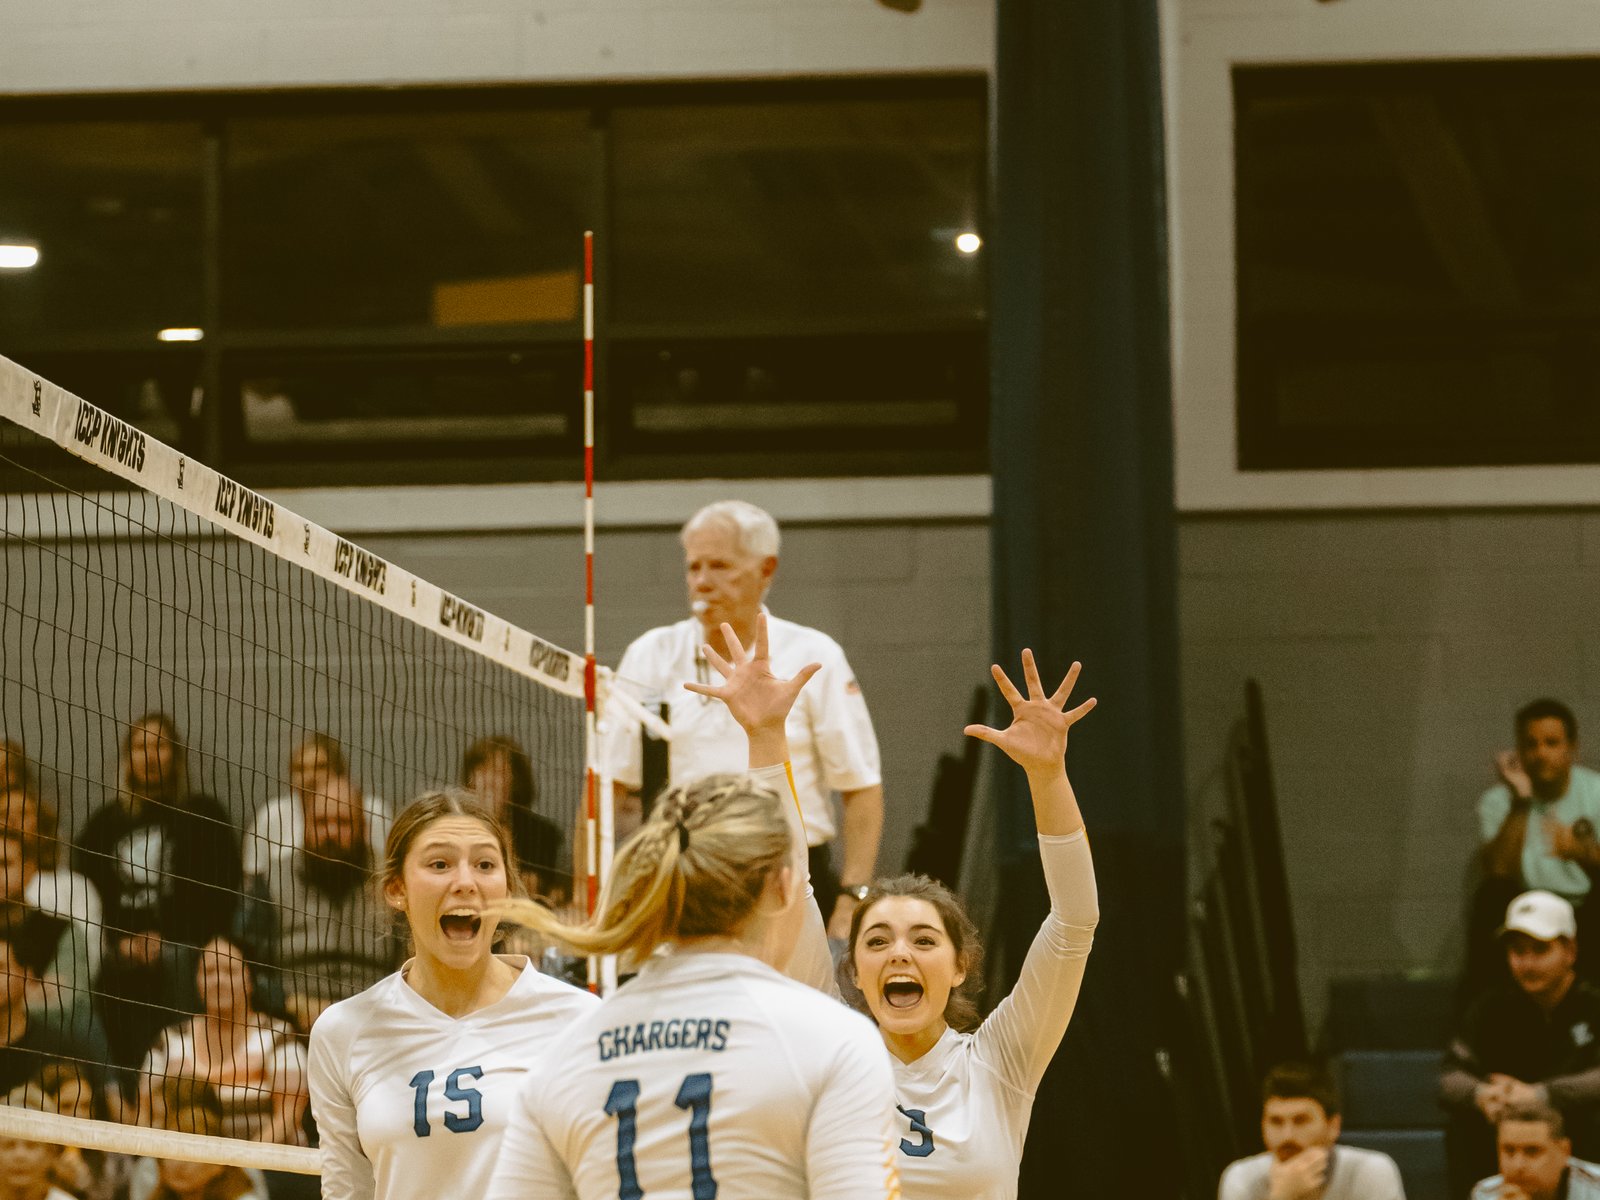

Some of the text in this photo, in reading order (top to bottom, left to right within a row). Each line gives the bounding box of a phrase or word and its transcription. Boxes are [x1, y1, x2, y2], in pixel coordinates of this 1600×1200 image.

[100, 414, 145, 472] KNIGHTS
[599, 1019, 731, 1061] CHARGERS
[409, 1066, 484, 1137] 15
